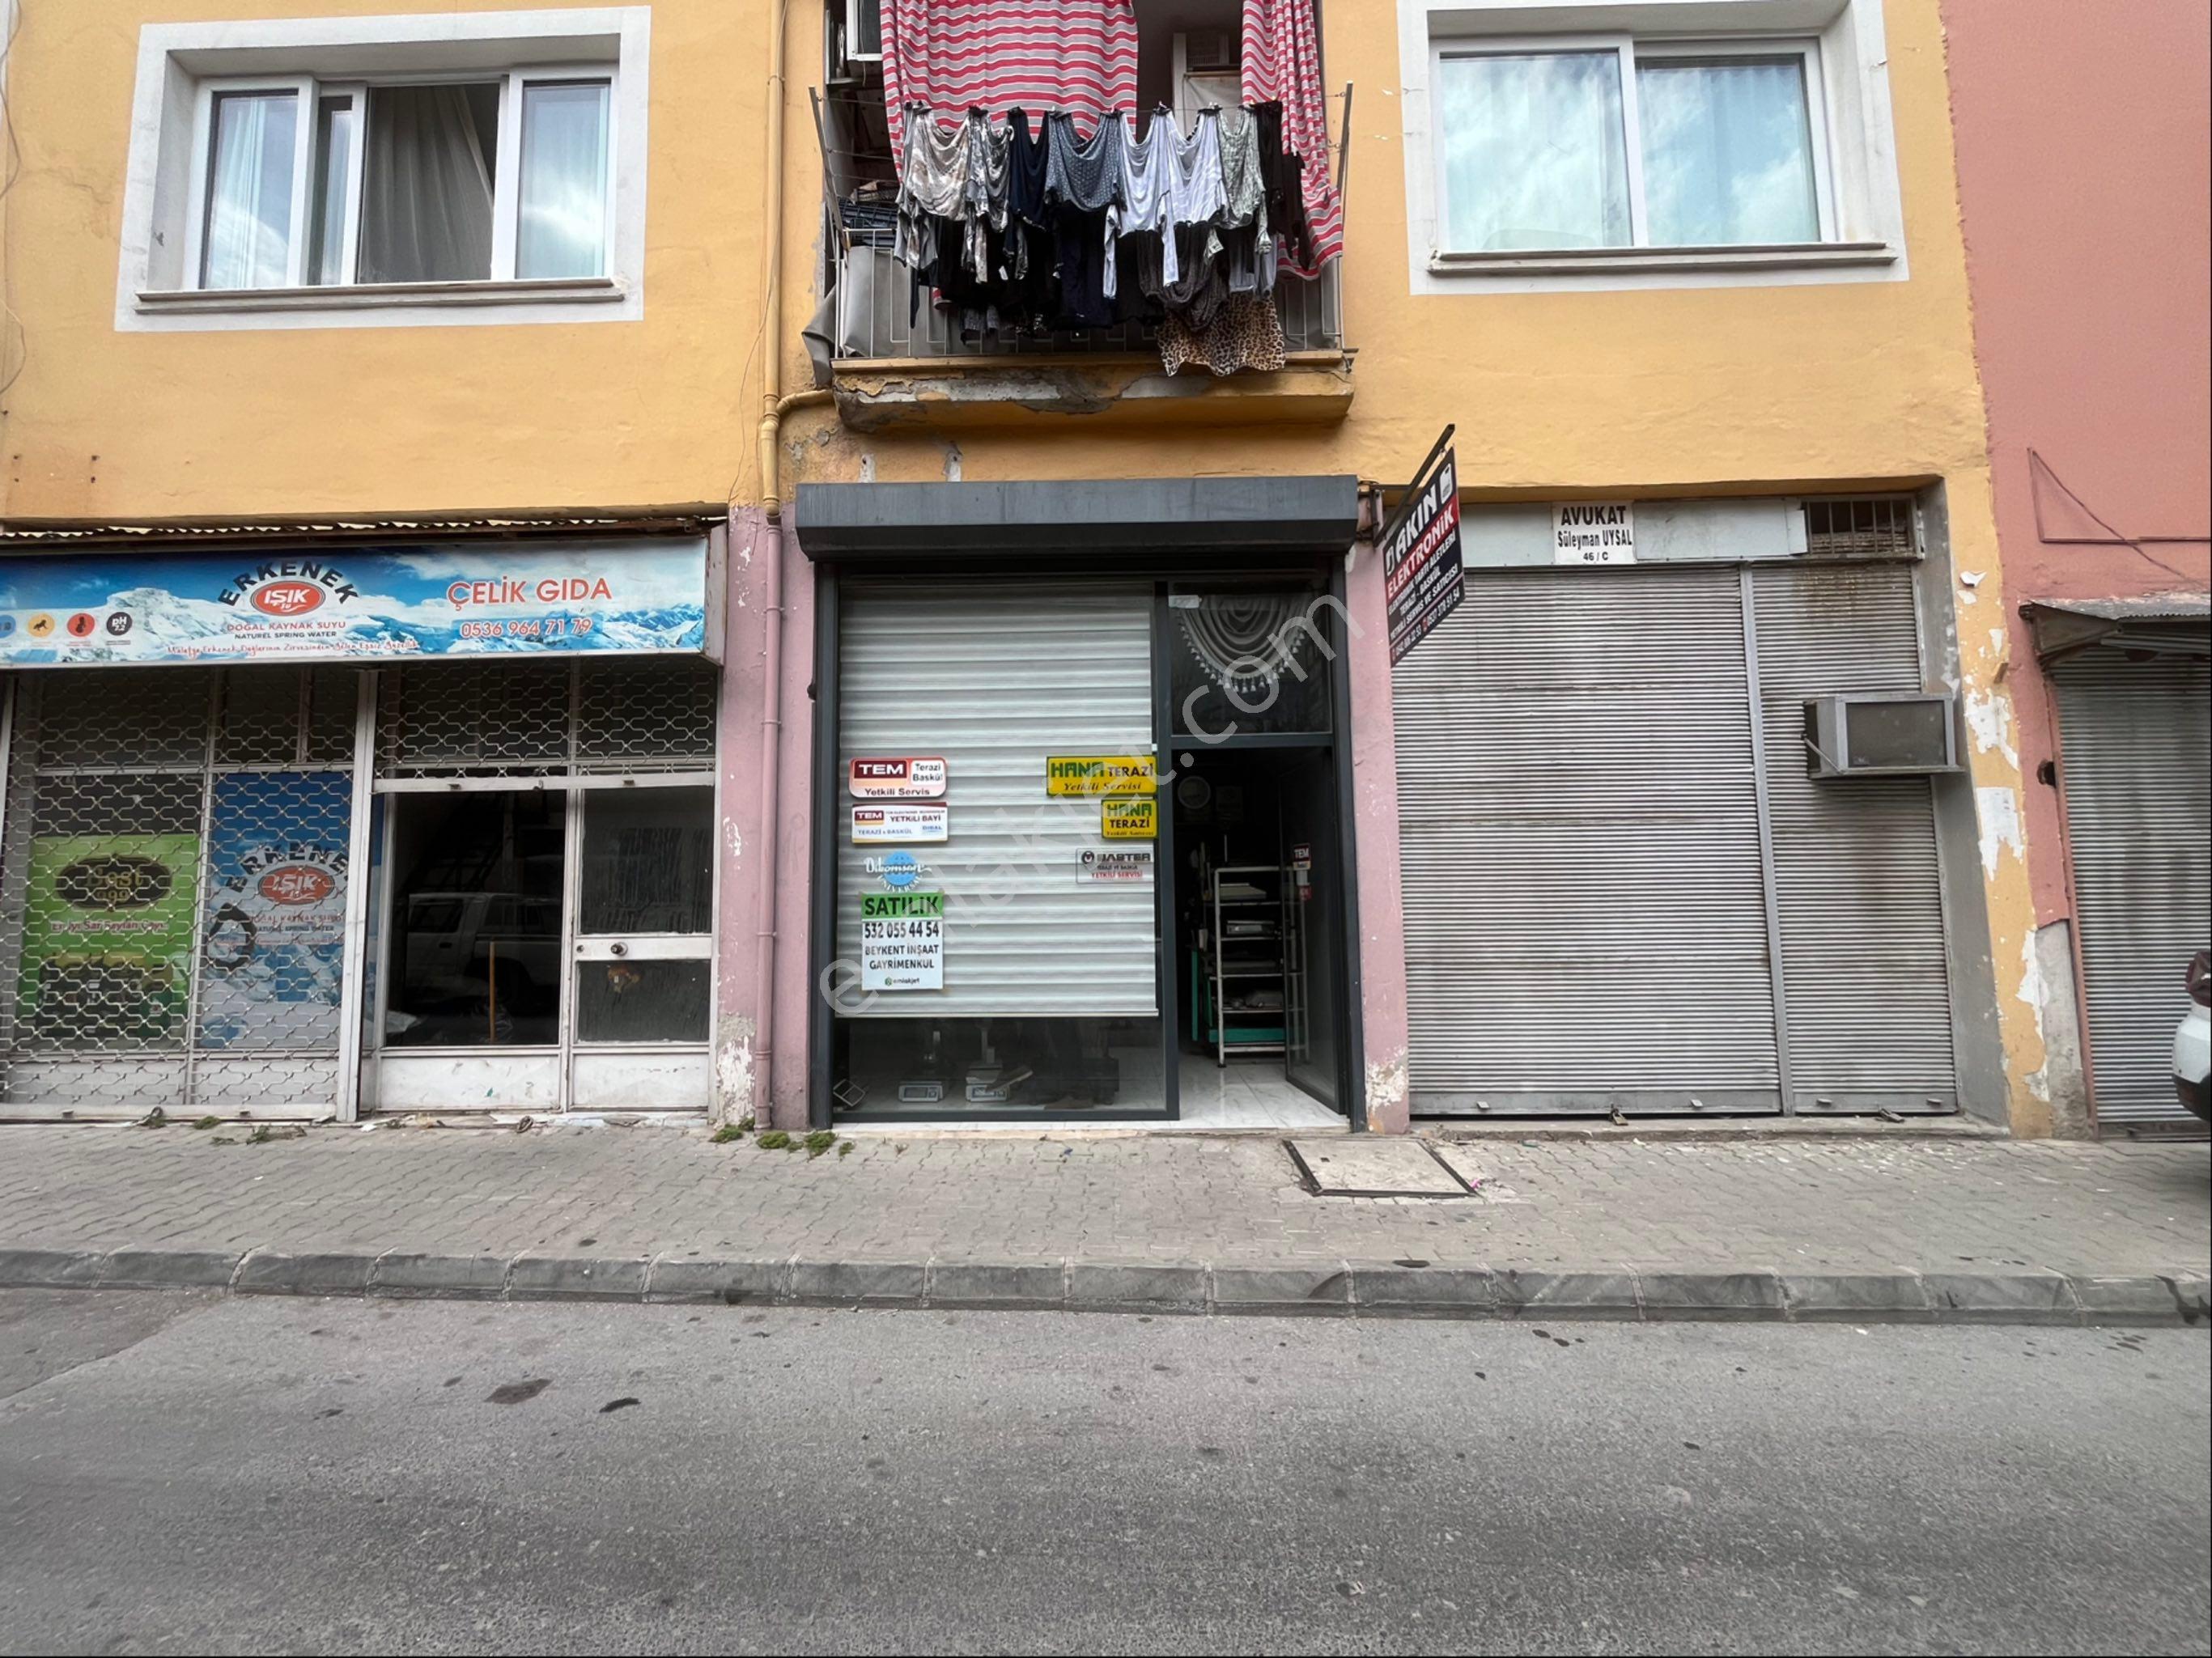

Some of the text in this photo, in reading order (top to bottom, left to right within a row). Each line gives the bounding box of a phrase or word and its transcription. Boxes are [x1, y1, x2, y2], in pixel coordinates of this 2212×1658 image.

[1561, 506, 1626, 525] AVUKAT
[1395, 483, 1437, 563] AKIN
[1557, 529, 1632, 550] Süleyman UYSAL
[218, 560, 359, 606] ERKENEK
[264, 588, 311, 607] IŞIK
[448, 575, 612, 611] ÇELİK GIDA
[112, 617, 127, 627] pH
[227, 621, 346, 631] DOĞAL KAYNAK SUYU
[461, 618, 592, 638] 0536 964 71 79
[859, 764, 903, 775] TEM
[915, 763, 940, 771] Terazi
[1051, 761, 1153, 777] HANA TERAZİ
[913, 774, 942, 782] Baskül
[1064, 782, 1098, 791] Yetkili
[1107, 804, 1152, 816] HANA
[922, 814, 941, 822] BAYİ
[1110, 816, 1149, 829] TERAZİ
[864, 896, 939, 915] SATILIK
[864, 921, 939, 939] 532 055 44 54
[864, 943, 939, 956] BEYKENT İNŞAAT
[869, 957, 934, 969] GAYRİMENKUL
